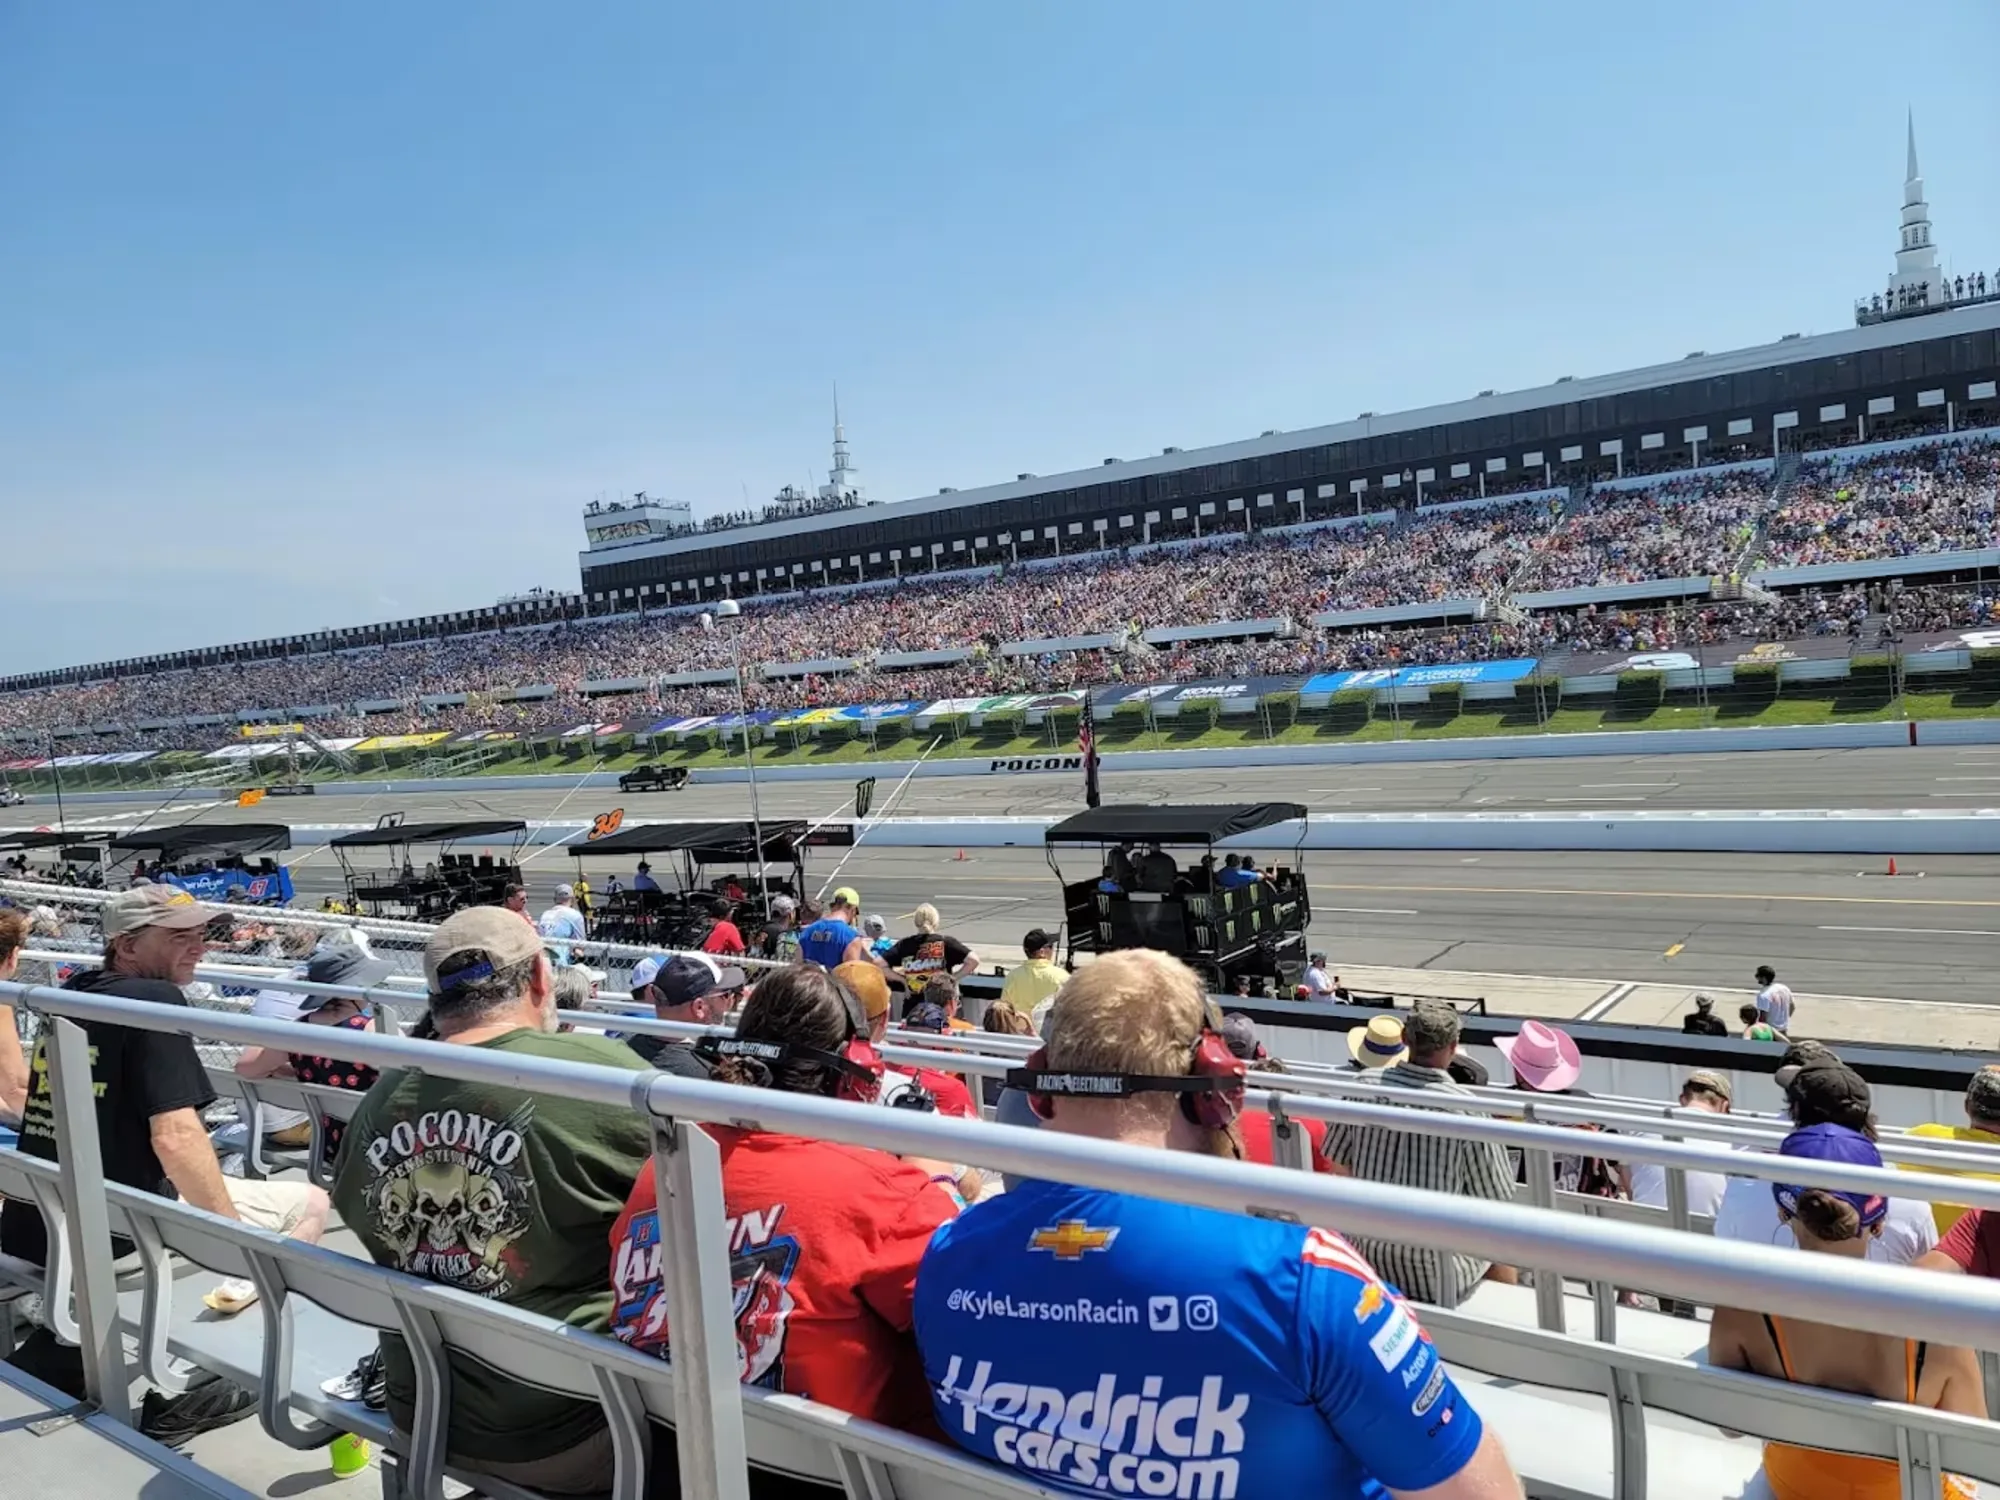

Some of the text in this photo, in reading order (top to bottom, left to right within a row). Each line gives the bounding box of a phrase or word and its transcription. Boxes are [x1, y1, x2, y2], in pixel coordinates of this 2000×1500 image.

[1036, 1074, 1122, 1094] RACING ELECTRONICS
[366, 1109, 524, 1177] POCONO
[386, 1148, 496, 1184] PENNSYLVANIA
[430, 1252, 473, 1277] TRACK
[946, 1288, 1140, 1325] @KyleLarsonRacin
[935, 1353, 1250, 1458] Hendrick
[993, 1424, 1241, 1500] cars.com
